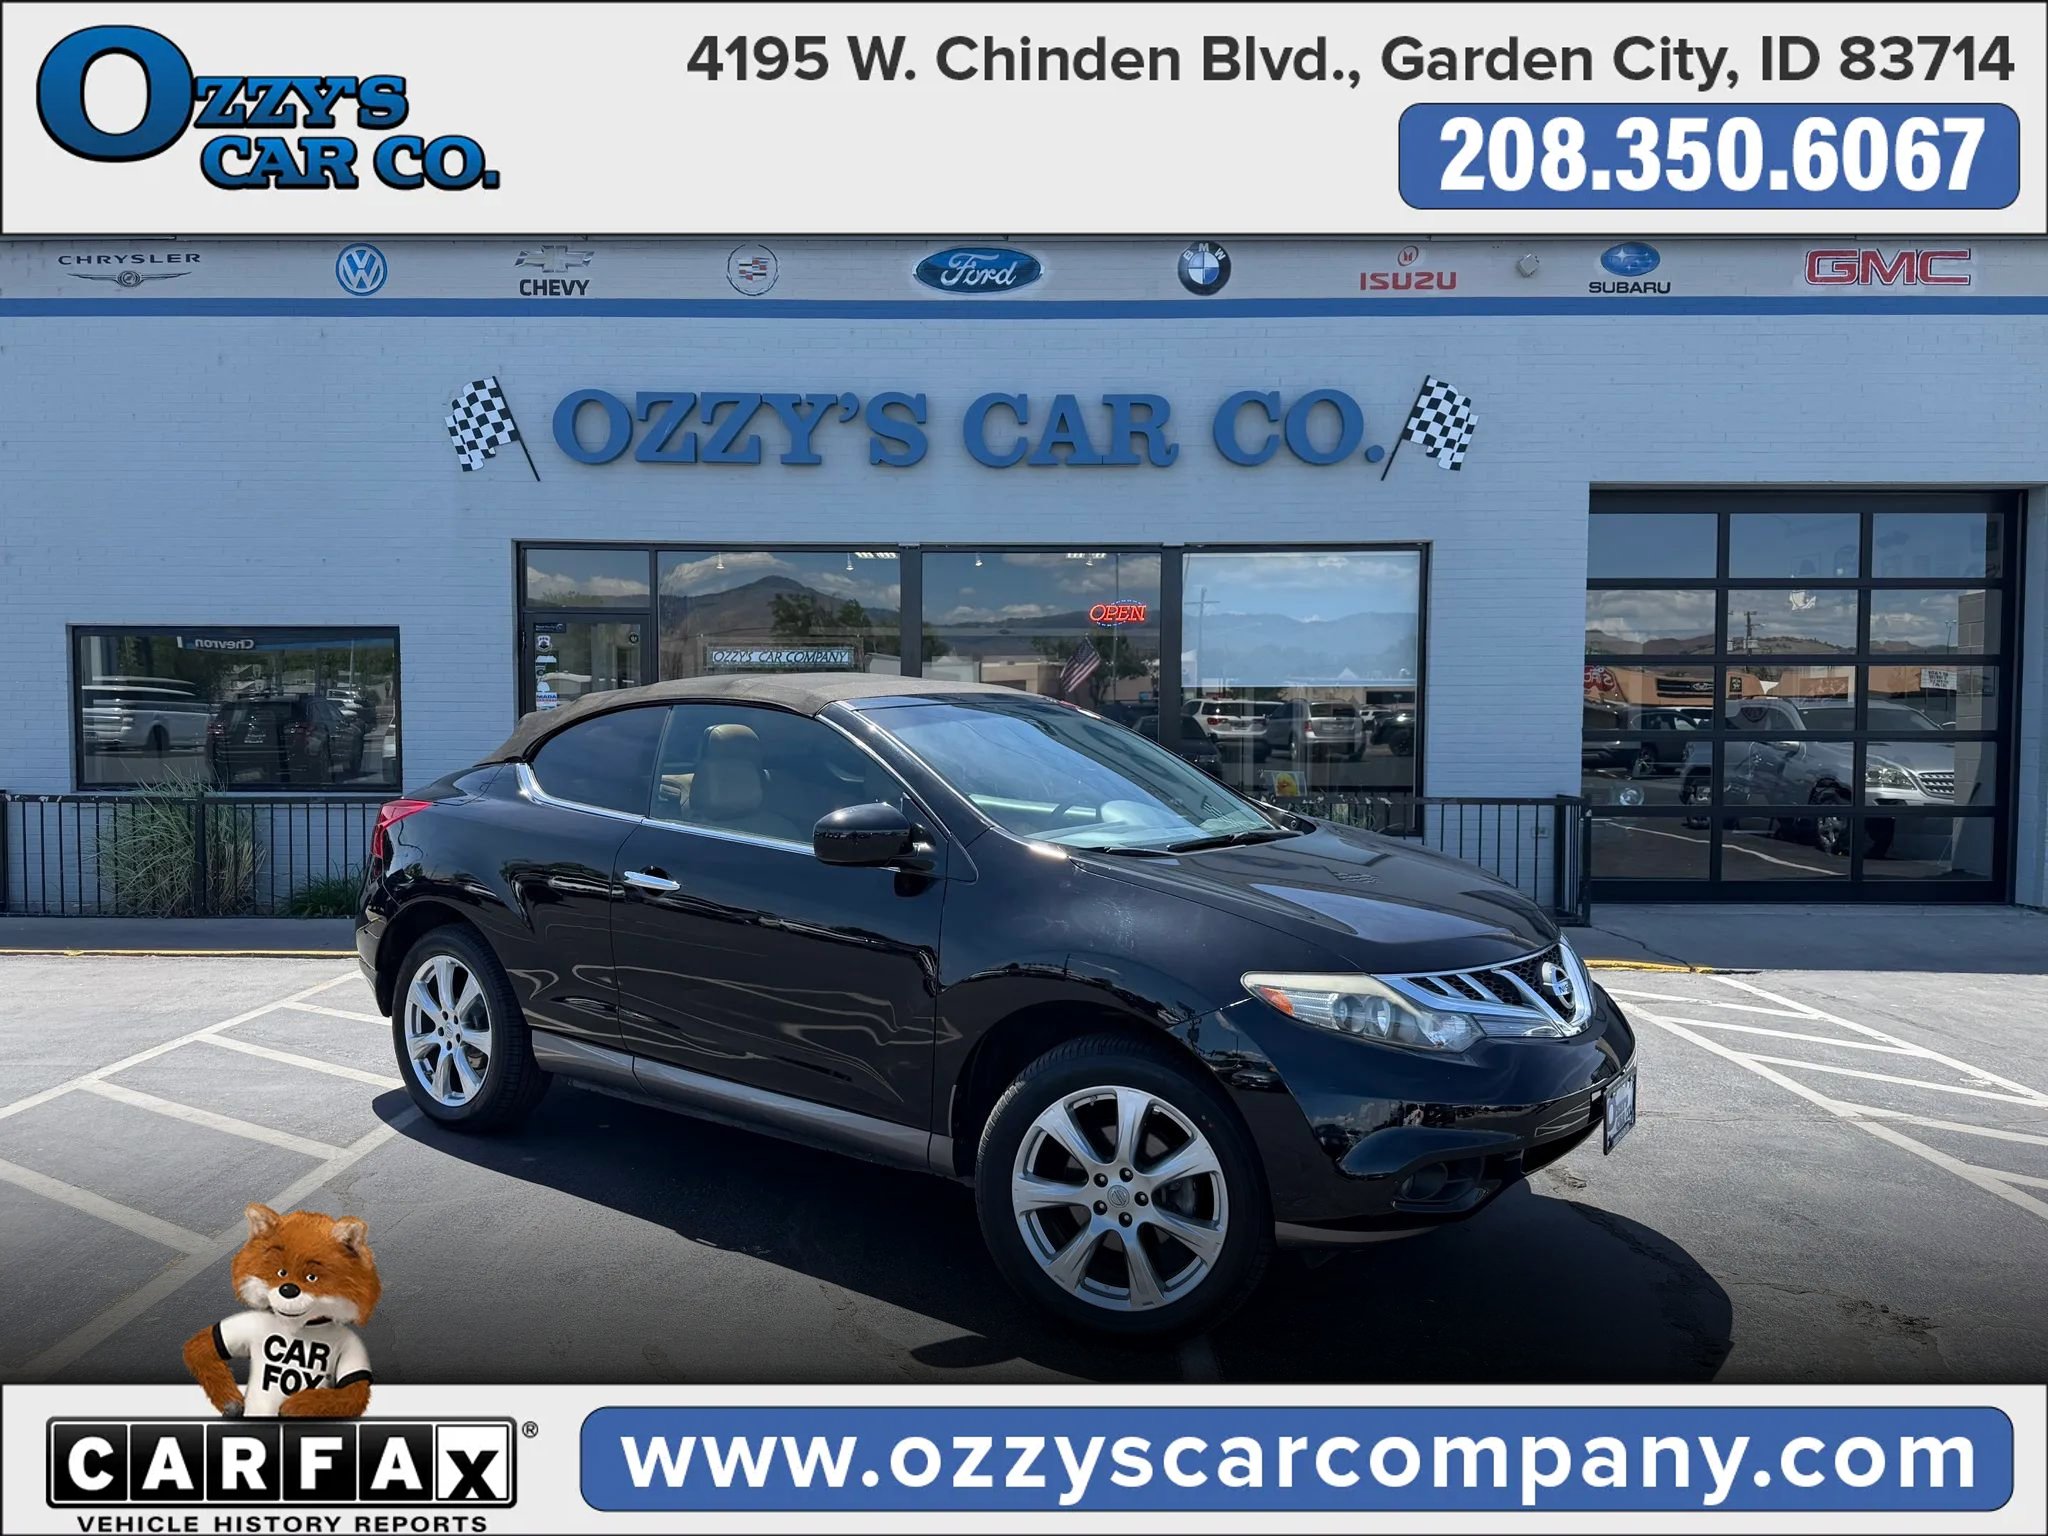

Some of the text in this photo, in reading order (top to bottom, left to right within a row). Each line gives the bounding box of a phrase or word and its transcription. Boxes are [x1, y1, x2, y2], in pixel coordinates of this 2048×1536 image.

[58, 252, 200, 266] CHRYSLER
[1183, 242, 1226, 260] BMW
[940, 252, 1017, 287] Ford
[1805, 249, 1971, 286] GMC
[519, 279, 590, 297] CHEVY
[1360, 271, 1457, 291] ISUZU
[1588, 281, 1671, 294] SUBARU
[552, 388, 1386, 468] OZZY'S CAR CO.
[1089, 603, 1147, 622] OPEN
[713, 650, 847, 663] OZZY'S CAR COMPANY
